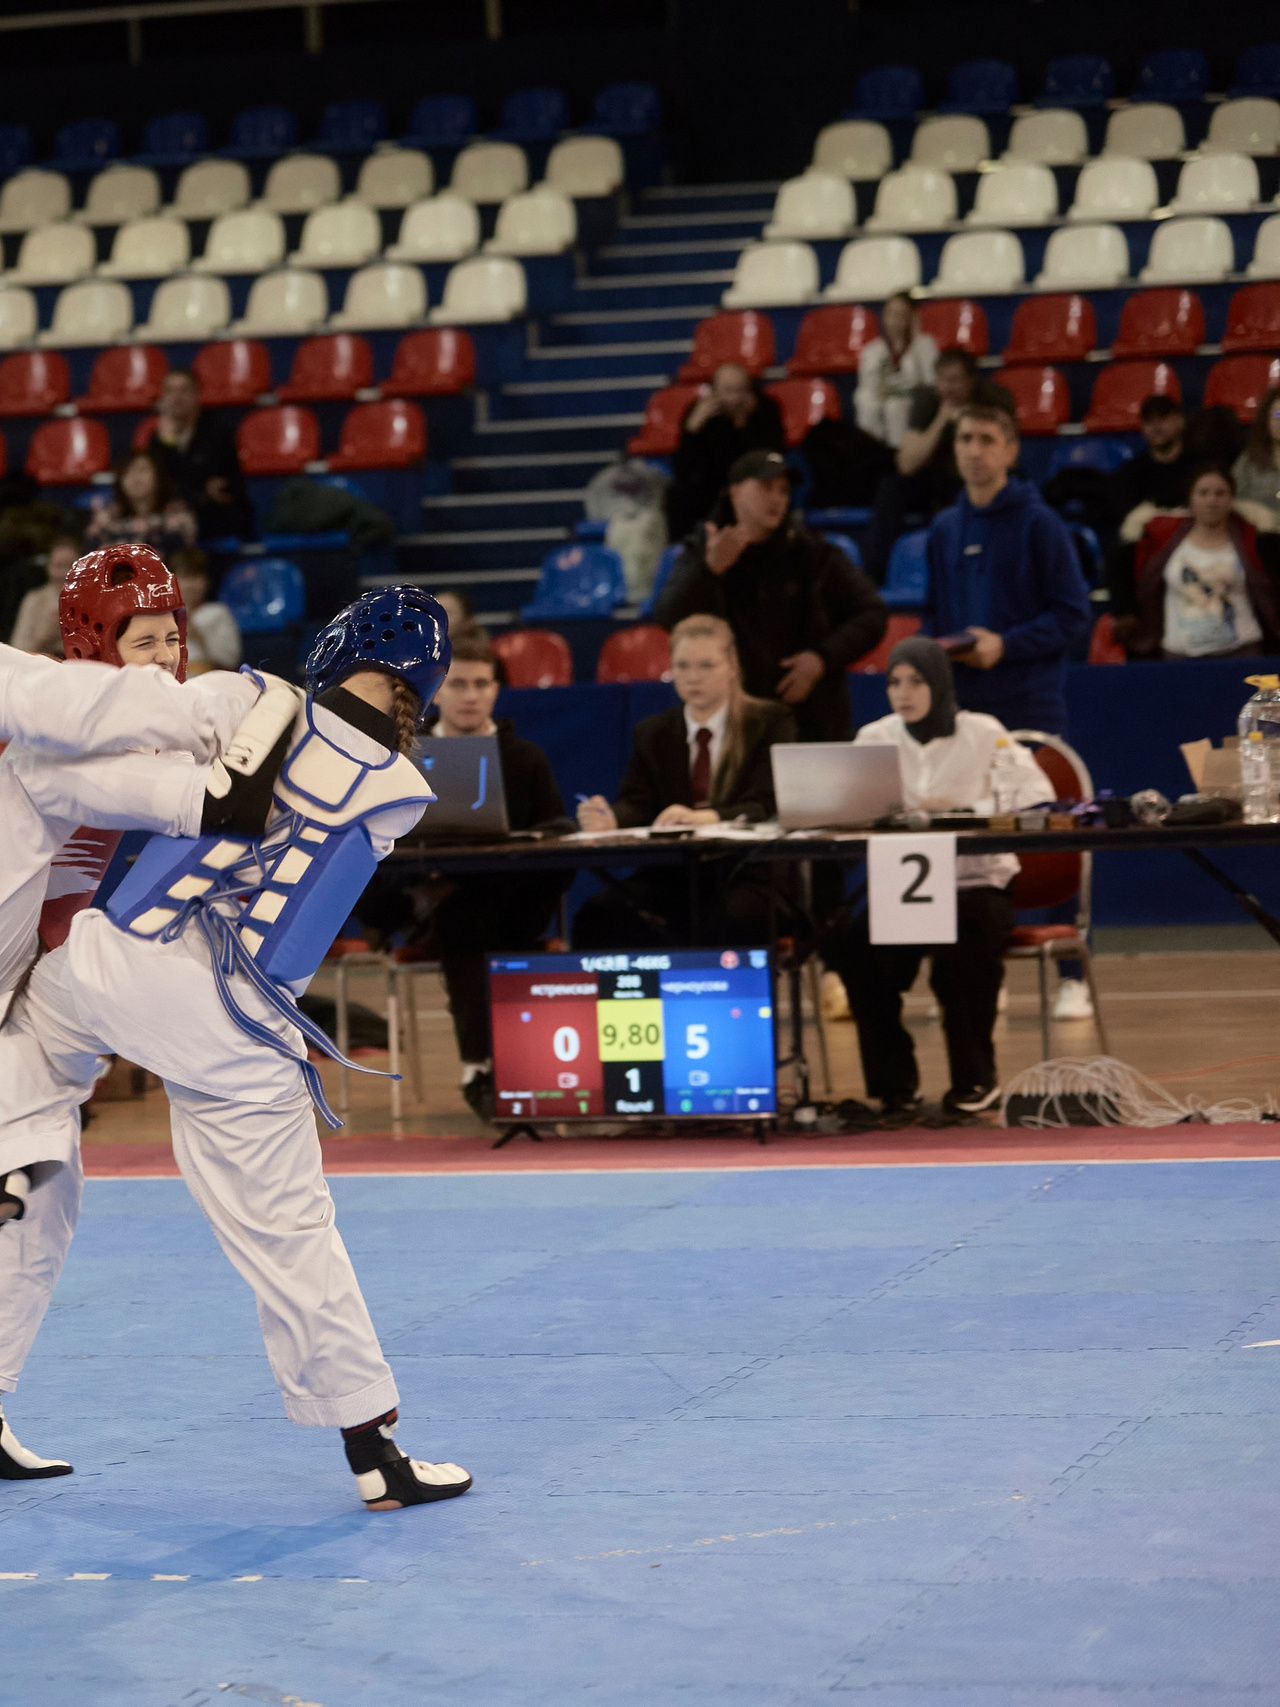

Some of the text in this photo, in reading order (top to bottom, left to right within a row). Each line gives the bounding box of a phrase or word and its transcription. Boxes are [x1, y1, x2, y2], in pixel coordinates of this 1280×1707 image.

[901, 853, 933, 904] 2
[553, 1026, 580, 1062] 0
[603, 1024, 660, 1049] 9,80
[686, 1024, 709, 1059] 5
[625, 1068, 641, 1093] 1
